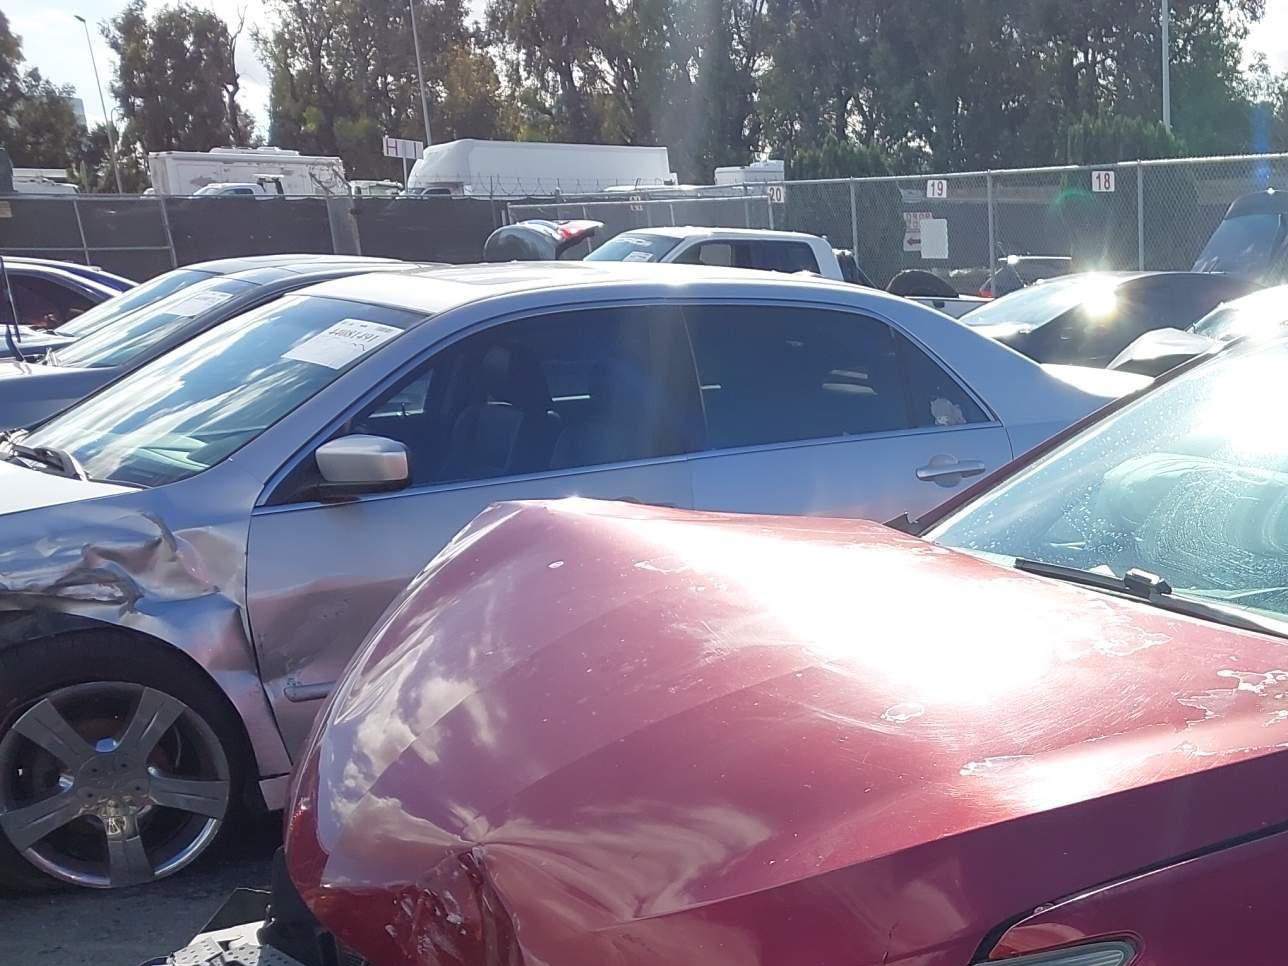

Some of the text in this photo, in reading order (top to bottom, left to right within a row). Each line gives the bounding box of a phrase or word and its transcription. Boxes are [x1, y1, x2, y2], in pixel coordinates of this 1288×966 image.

[930, 181, 944, 197] 19
[1095, 172, 1111, 191] 18
[769, 187, 782, 202] 20
